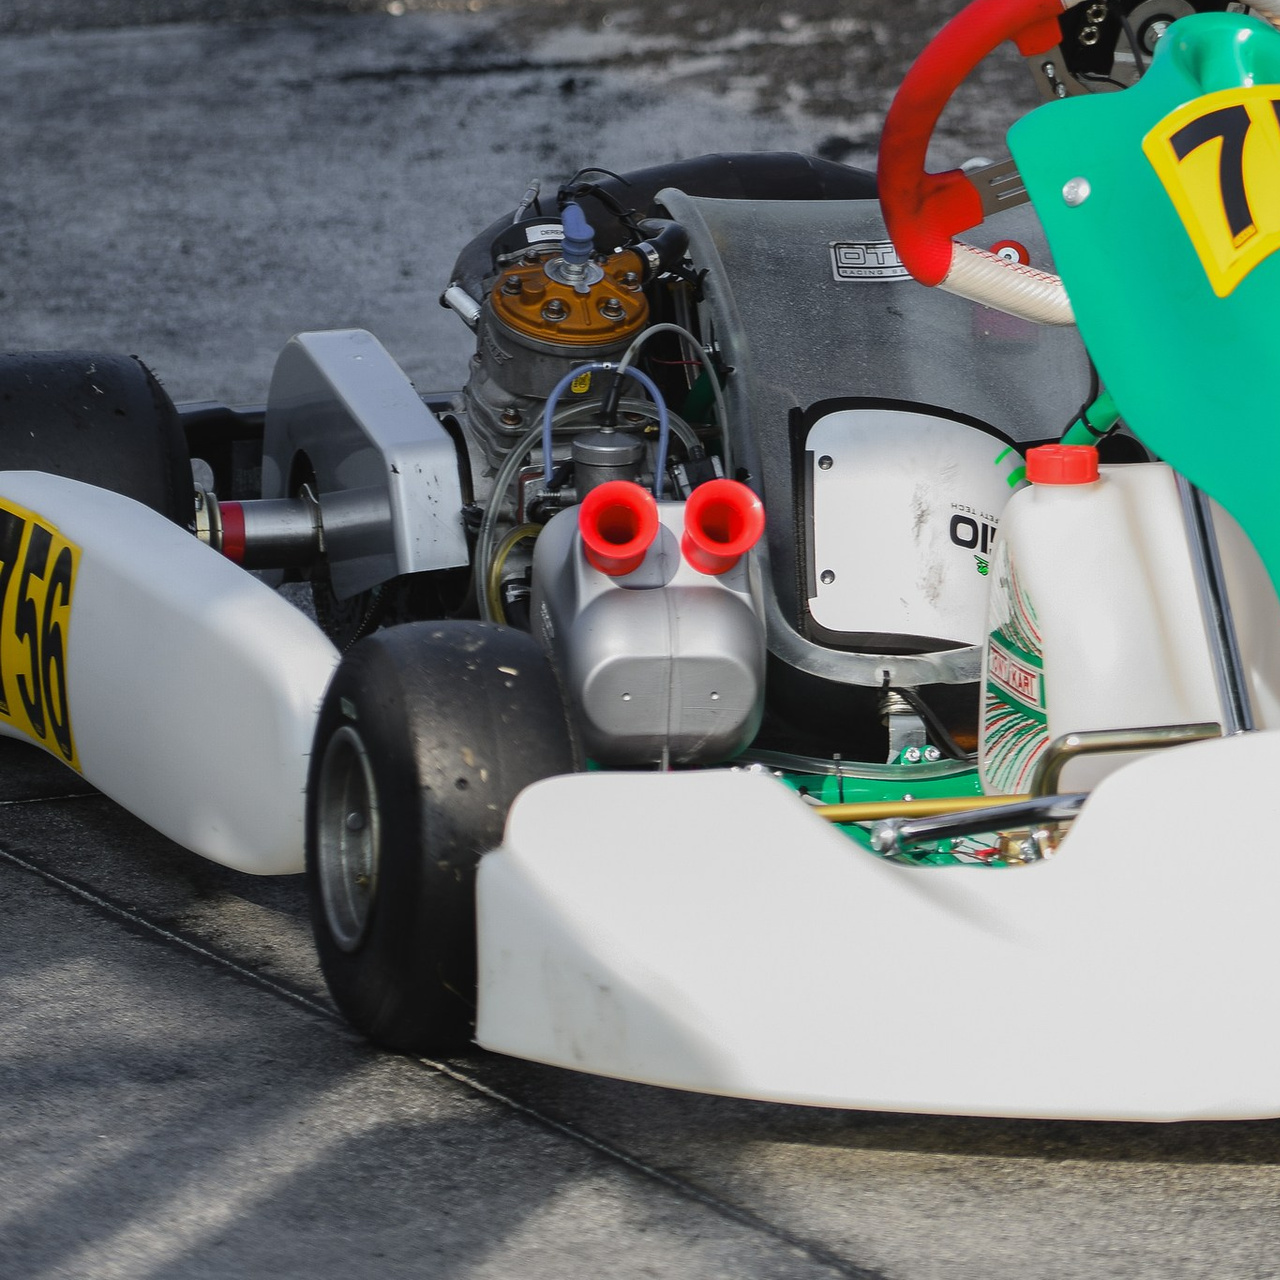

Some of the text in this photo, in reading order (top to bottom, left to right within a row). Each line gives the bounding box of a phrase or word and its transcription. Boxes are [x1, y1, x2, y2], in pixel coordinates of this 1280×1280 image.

[840, 247, 903, 265] OT
[950, 502, 977, 515] TECH
[1010, 662, 1037, 697] KART
